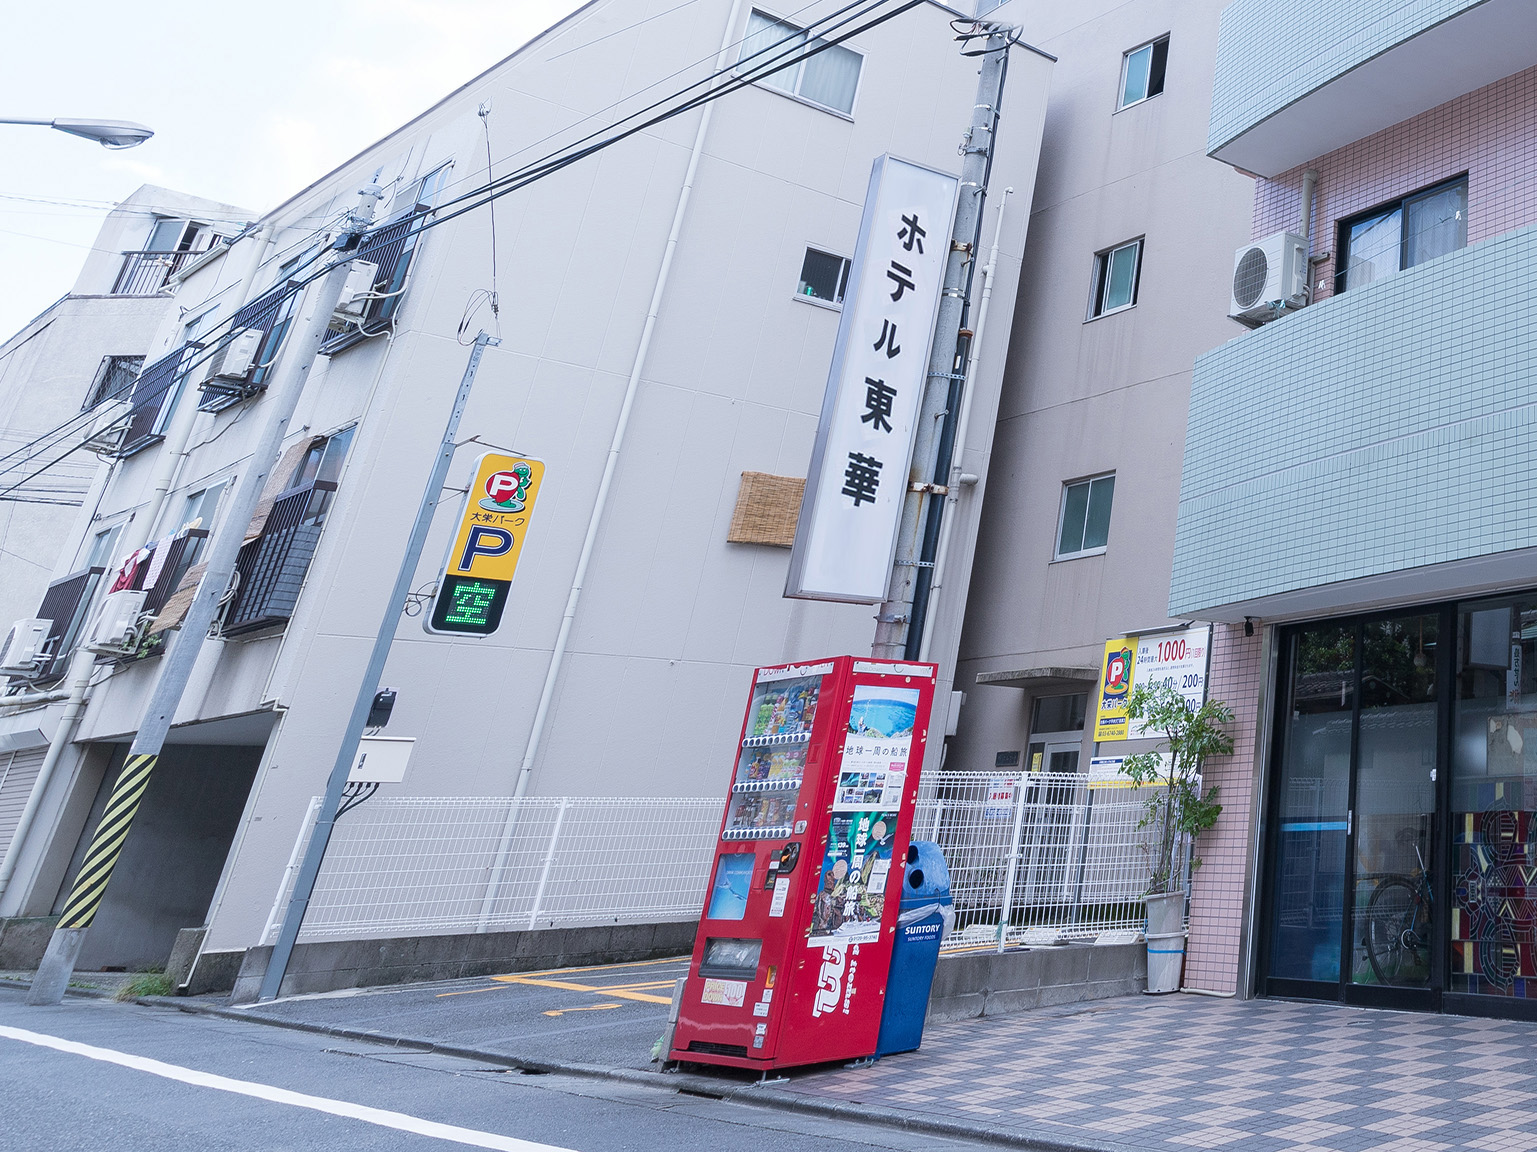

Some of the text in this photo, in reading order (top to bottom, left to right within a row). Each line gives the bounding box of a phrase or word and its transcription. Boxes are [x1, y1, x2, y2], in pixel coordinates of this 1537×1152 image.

[841, 214, 927, 507] ホテル東華
[489, 474, 519, 496] P
[470, 512, 526, 527] 大栄パーク
[458, 524, 514, 572] P
[445, 582, 496, 625] 空
[845, 745, 908, 757] 地球一周の船旅
[842, 817, 870, 917] 地球一周の船旅
